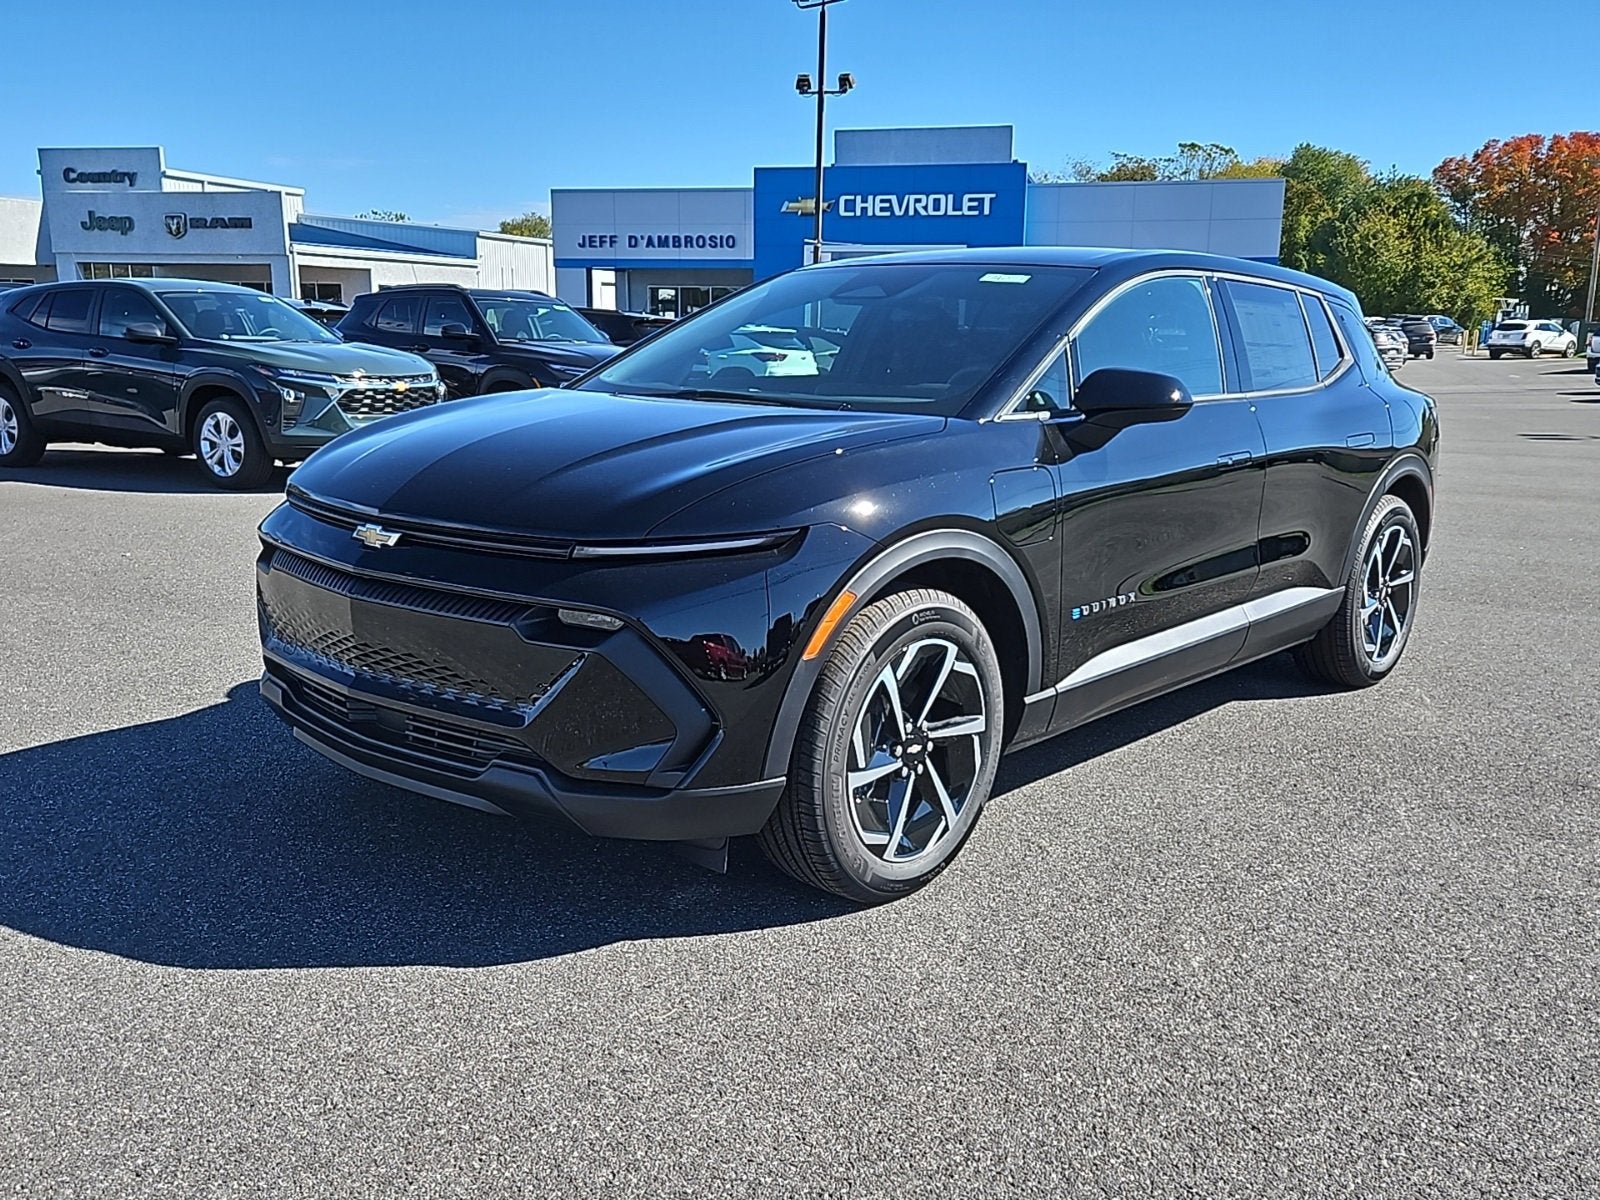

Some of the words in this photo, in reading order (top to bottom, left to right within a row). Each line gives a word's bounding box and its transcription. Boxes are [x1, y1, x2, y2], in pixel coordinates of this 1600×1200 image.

[62, 167, 138, 187] Country
[838, 193, 997, 217] CHEVROLET
[80, 210, 135, 236] Jeep
[189, 217, 253, 229] RAM
[577, 234, 618, 249] JEFF
[627, 234, 736, 249] D'AMBROSIO
[833, 709, 849, 763] PRIMACY
